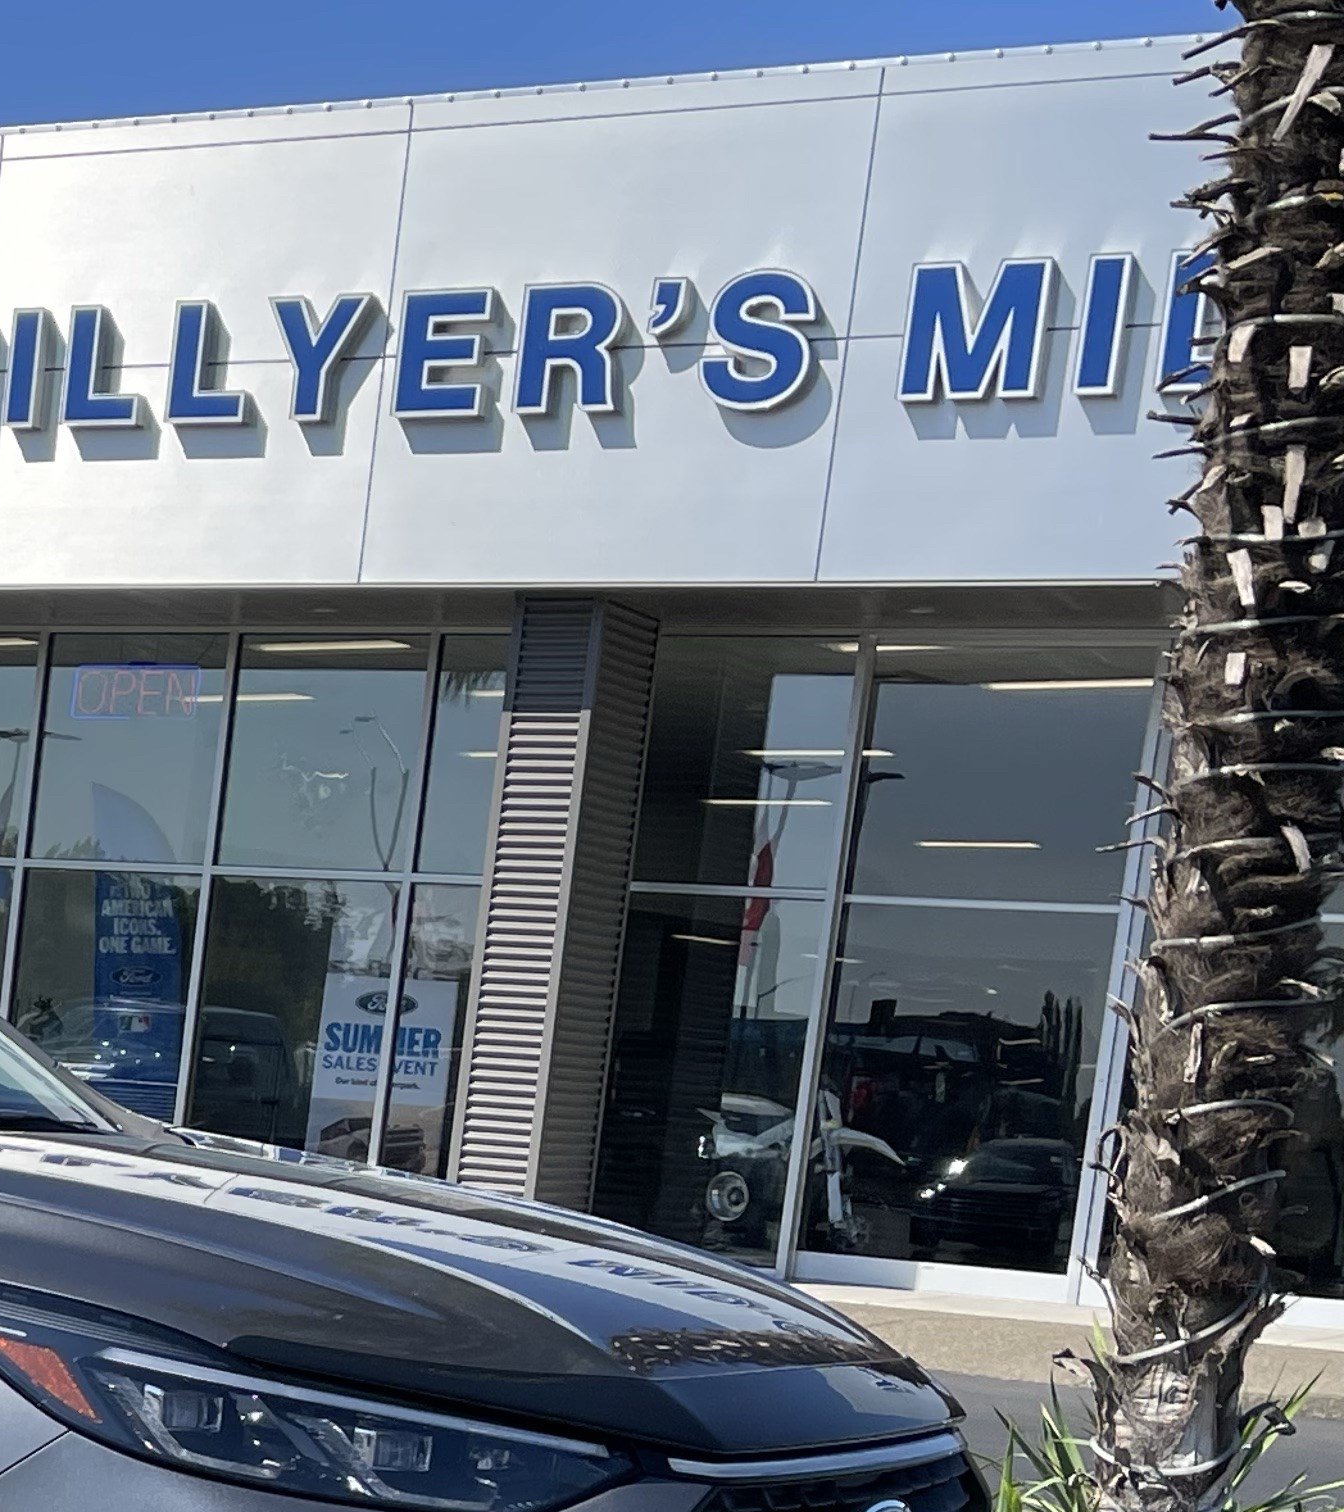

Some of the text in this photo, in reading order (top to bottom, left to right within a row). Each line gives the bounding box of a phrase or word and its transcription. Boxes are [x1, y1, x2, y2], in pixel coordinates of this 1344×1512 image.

[76, 668, 196, 716] OPEN
[101, 898, 174, 917] AMERICAN
[113, 917, 162, 936] ICONS.
[99, 936, 177, 955] ONE GAME.
[119, 969, 154, 983] Ford
[322, 1054, 378, 1072] SALES
